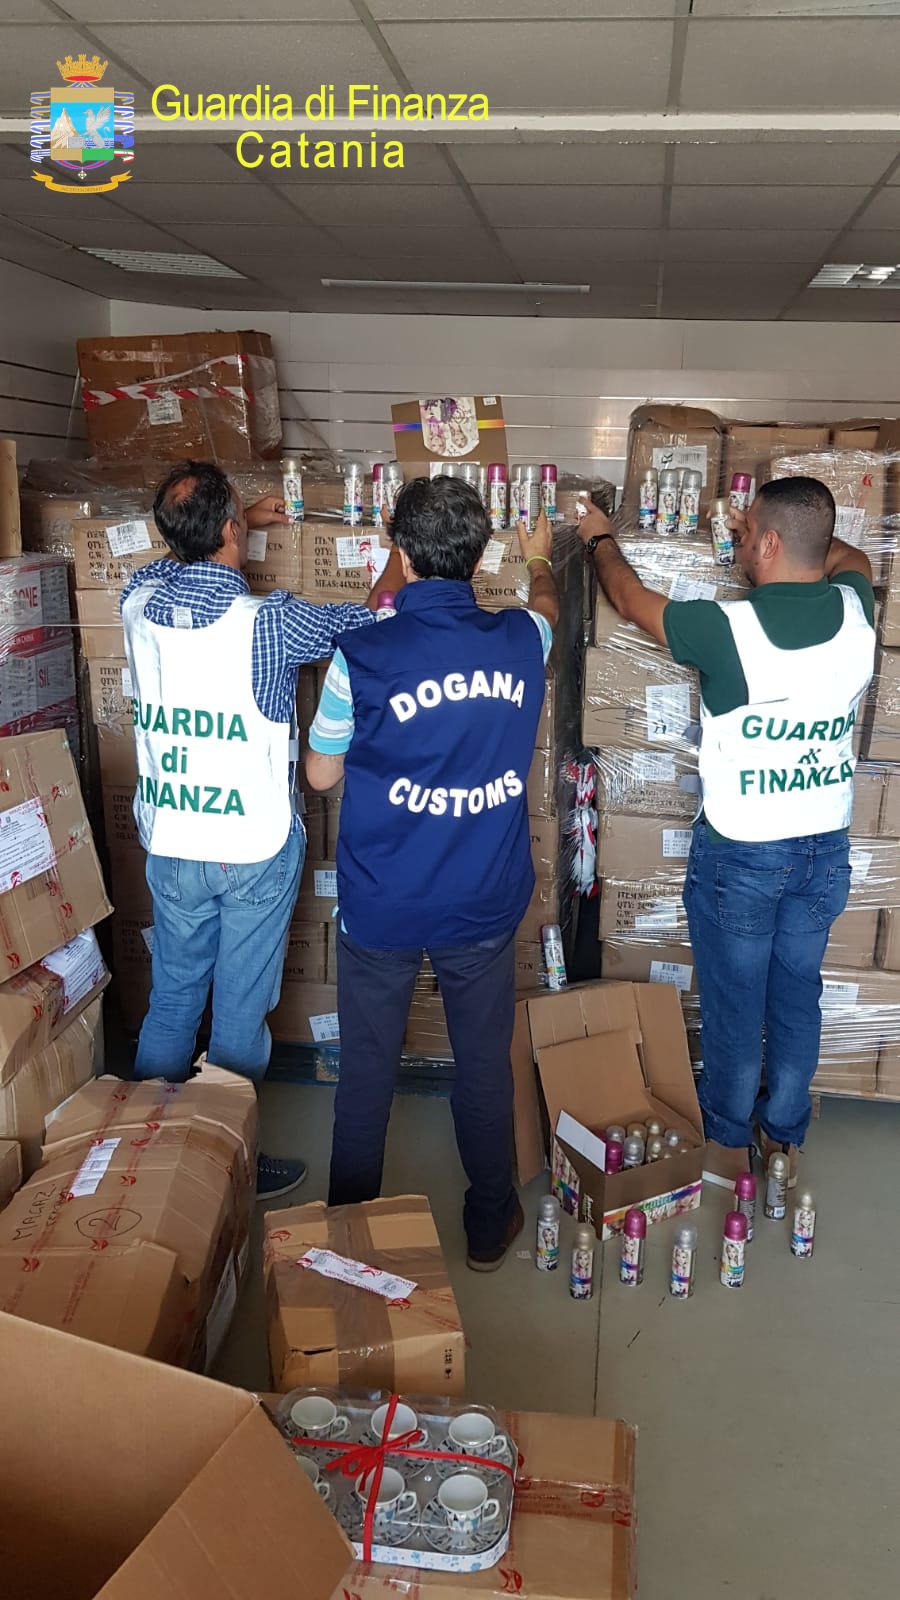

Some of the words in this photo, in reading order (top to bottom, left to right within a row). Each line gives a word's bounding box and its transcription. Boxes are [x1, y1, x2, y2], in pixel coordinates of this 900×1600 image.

[314, 547, 333, 556] QTY:
[314, 558, 332, 567] G.W:
[314, 568, 332, 577] N.W:
[336, 570, 341, 578] 6
[345, 570, 361, 578] KGS
[315, 578, 338, 588] MEAS:
[389, 670, 525, 723] DOGANA
[161, 746, 188, 774] di
[740, 760, 854, 795] FINANZA
[388, 769, 523, 818] CUSTOMS
[617, 901, 635, 910] QTY:
